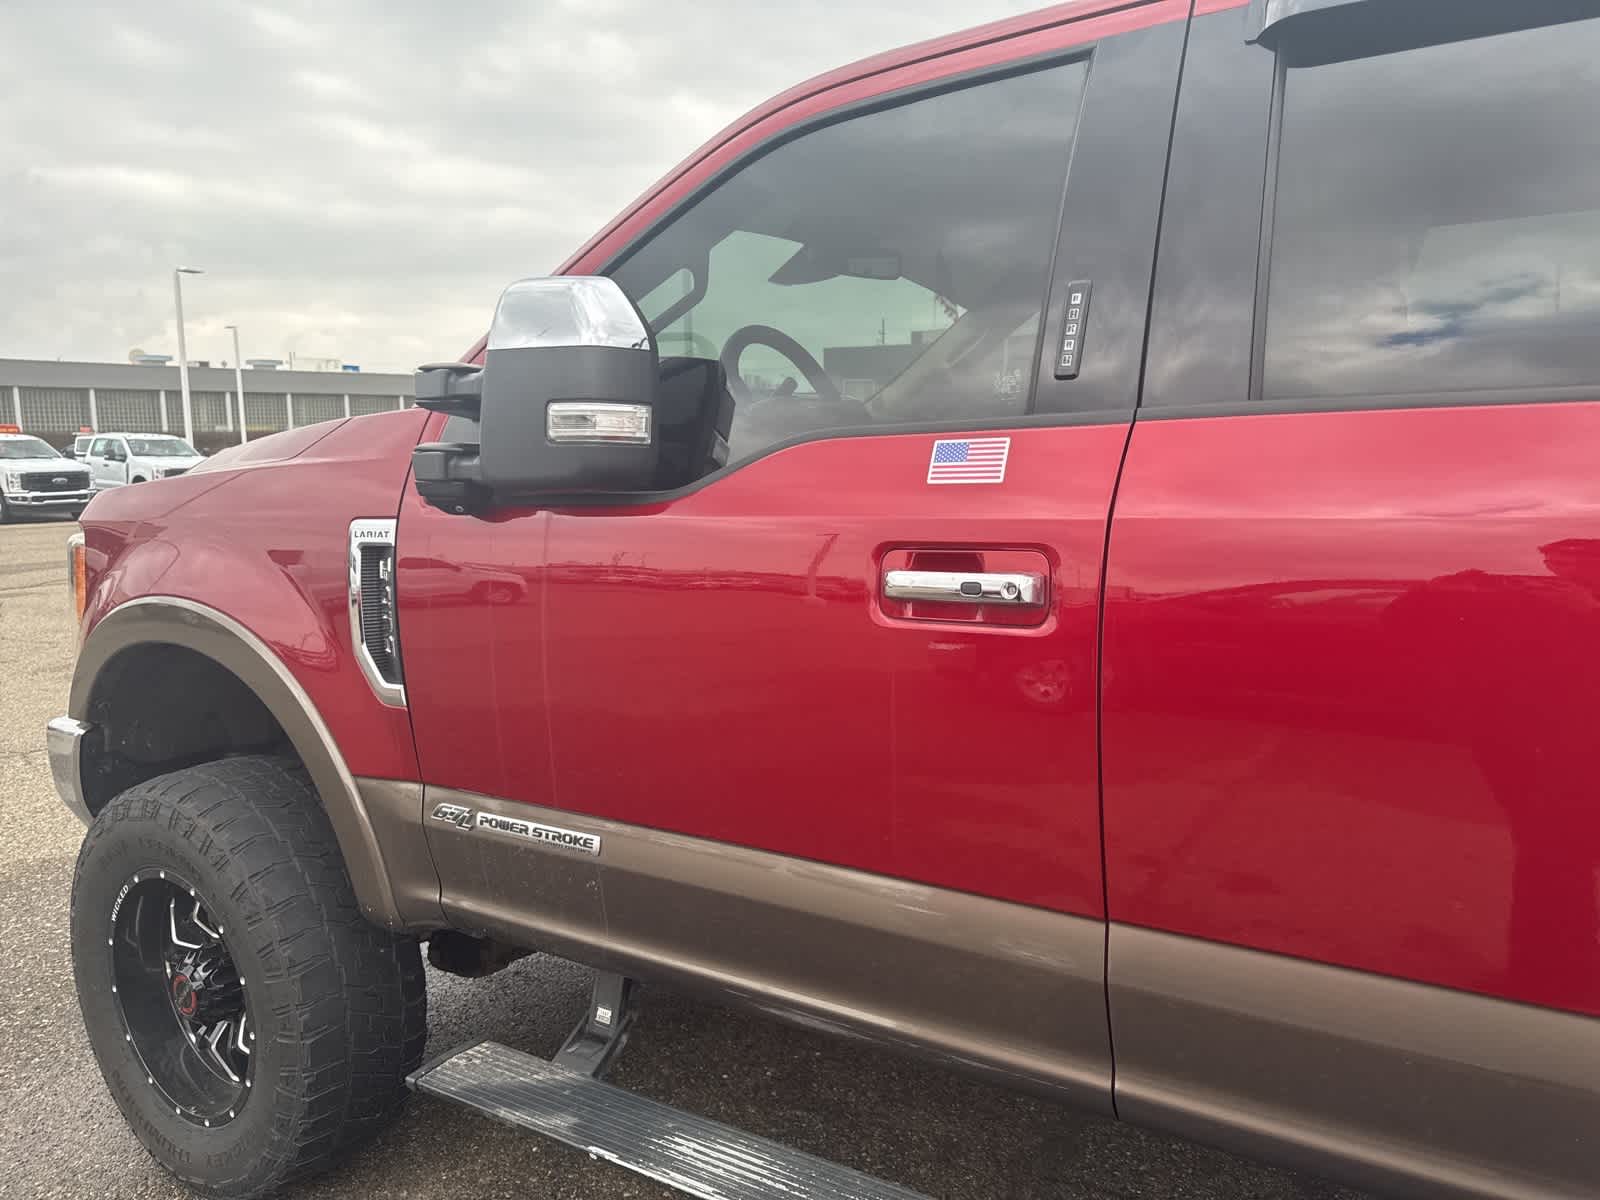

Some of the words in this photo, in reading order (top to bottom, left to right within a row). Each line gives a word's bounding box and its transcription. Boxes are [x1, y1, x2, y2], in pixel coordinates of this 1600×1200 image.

[354, 530, 391, 539] LARIAT
[479, 816, 529, 835] POWER
[532, 828, 594, 849] STROKE
[111, 884, 129, 922] WICKED
